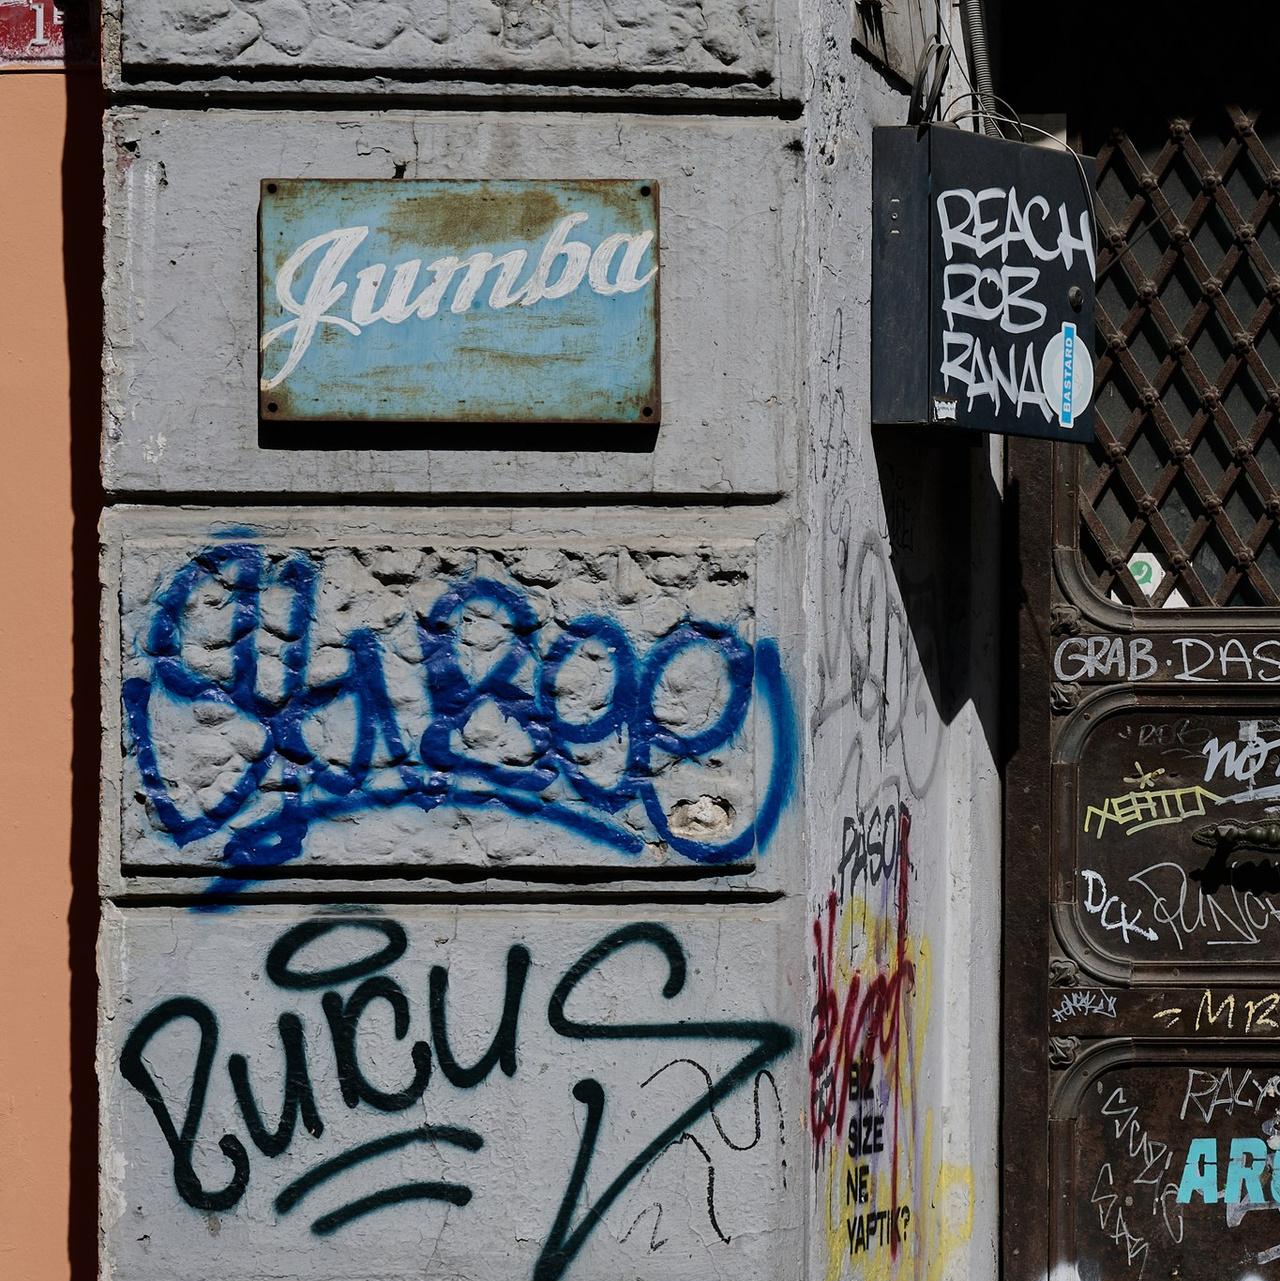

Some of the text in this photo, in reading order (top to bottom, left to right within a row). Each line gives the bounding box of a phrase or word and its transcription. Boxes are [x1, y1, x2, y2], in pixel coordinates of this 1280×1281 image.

[937, 187, 1096, 283] REACH
[261, 211, 659, 391] Jumba
[941, 263, 1048, 334] ROB
[939, 329, 1053, 423] RANA
[1061, 336, 1074, 414] BASTARD
[1053, 635, 1158, 682] GRAB
